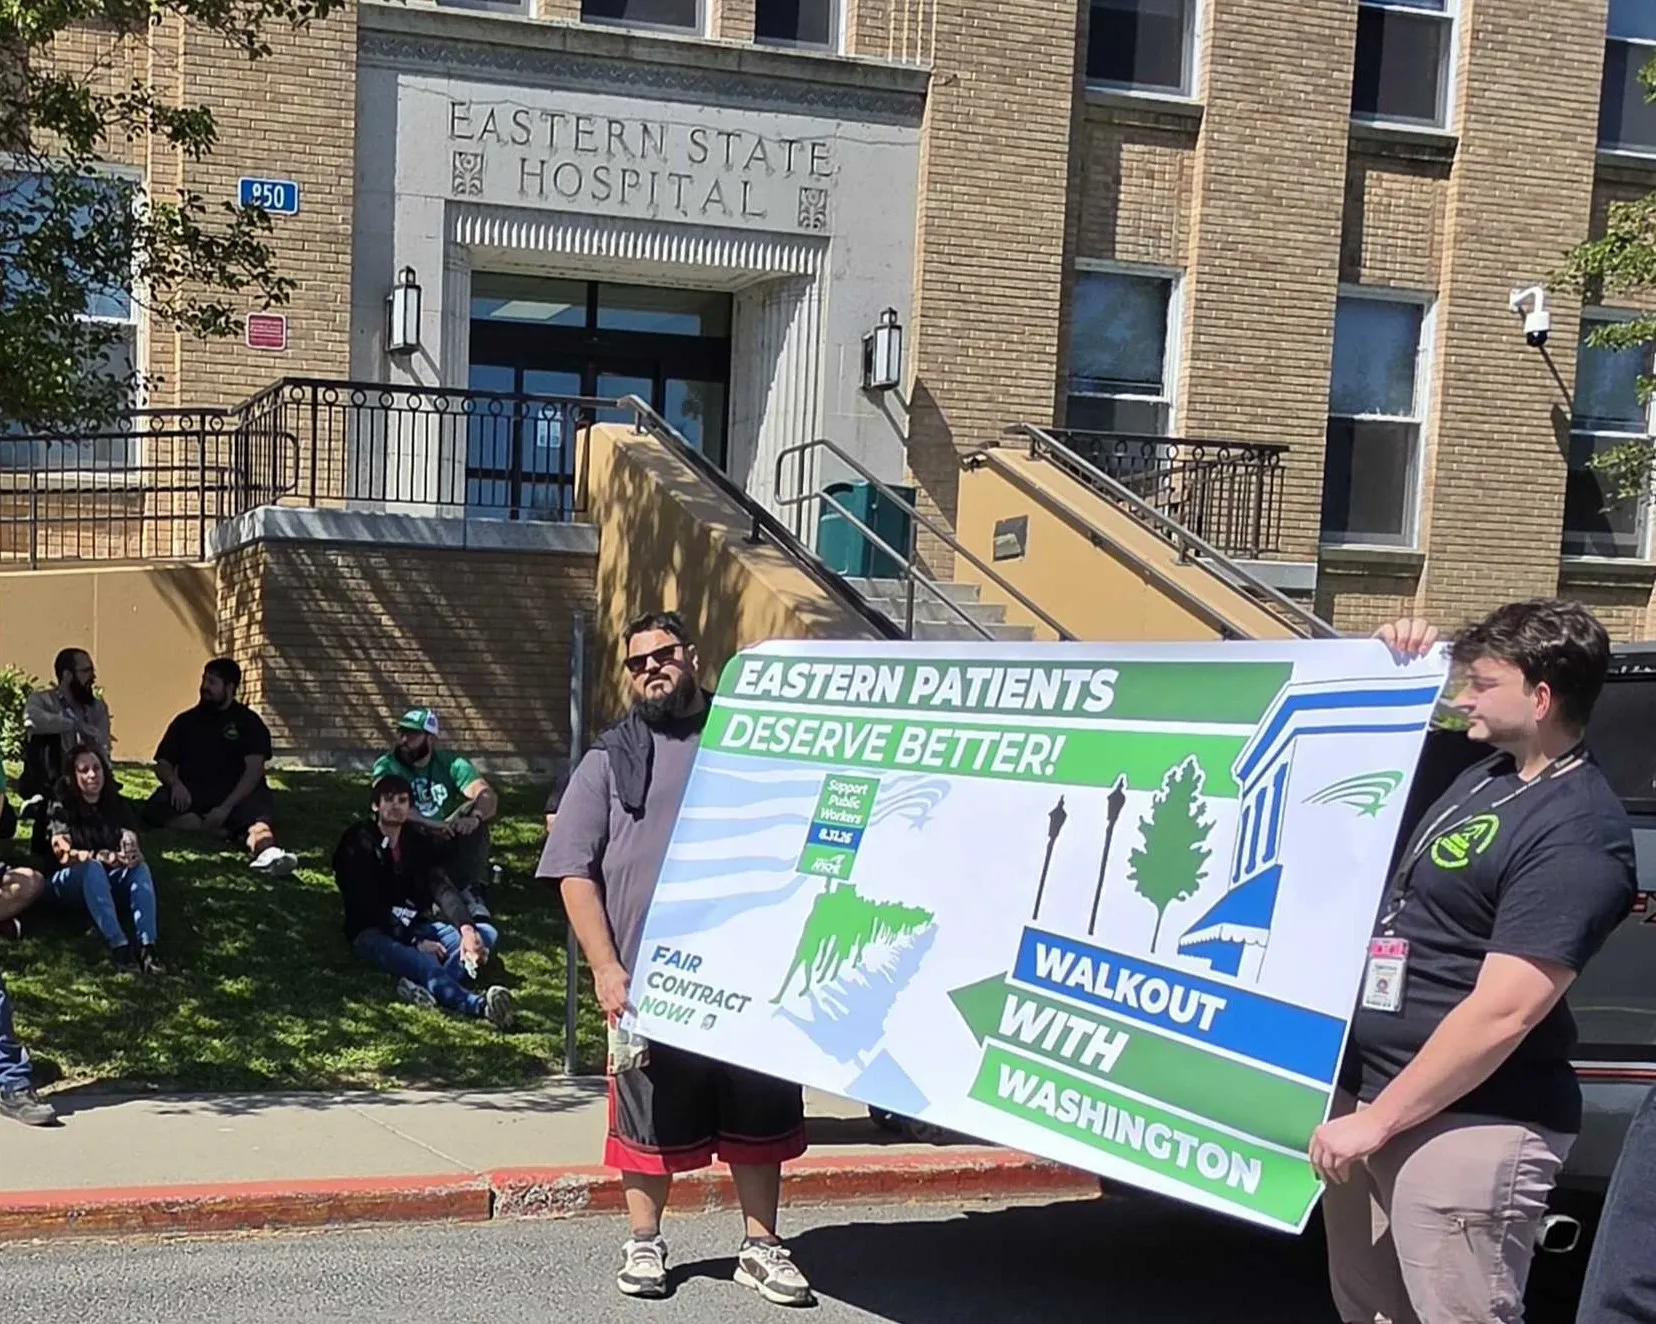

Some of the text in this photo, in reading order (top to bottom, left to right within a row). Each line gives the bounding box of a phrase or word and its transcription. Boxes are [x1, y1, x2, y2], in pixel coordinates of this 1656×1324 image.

[449, 101, 833, 179] EASTERN STATE
[517, 156, 768, 219] HOSPITAL
[734, 660, 1119, 712] EASTERN PATIENTS
[720, 714, 1067, 776] DESERVE BETTER!
[827, 779, 869, 795] Support
[828, 794, 861, 809] Public
[820, 807, 863, 824] Workers
[651, 945, 703, 973] FAIR
[639, 995, 696, 1025] NOW!
[646, 971, 752, 1013] CONTRACT
[1035, 942, 1227, 1032] WALKOUT
[999, 994, 1130, 1073] WITH
[997, 1063, 1262, 1194] WASHINGTON
